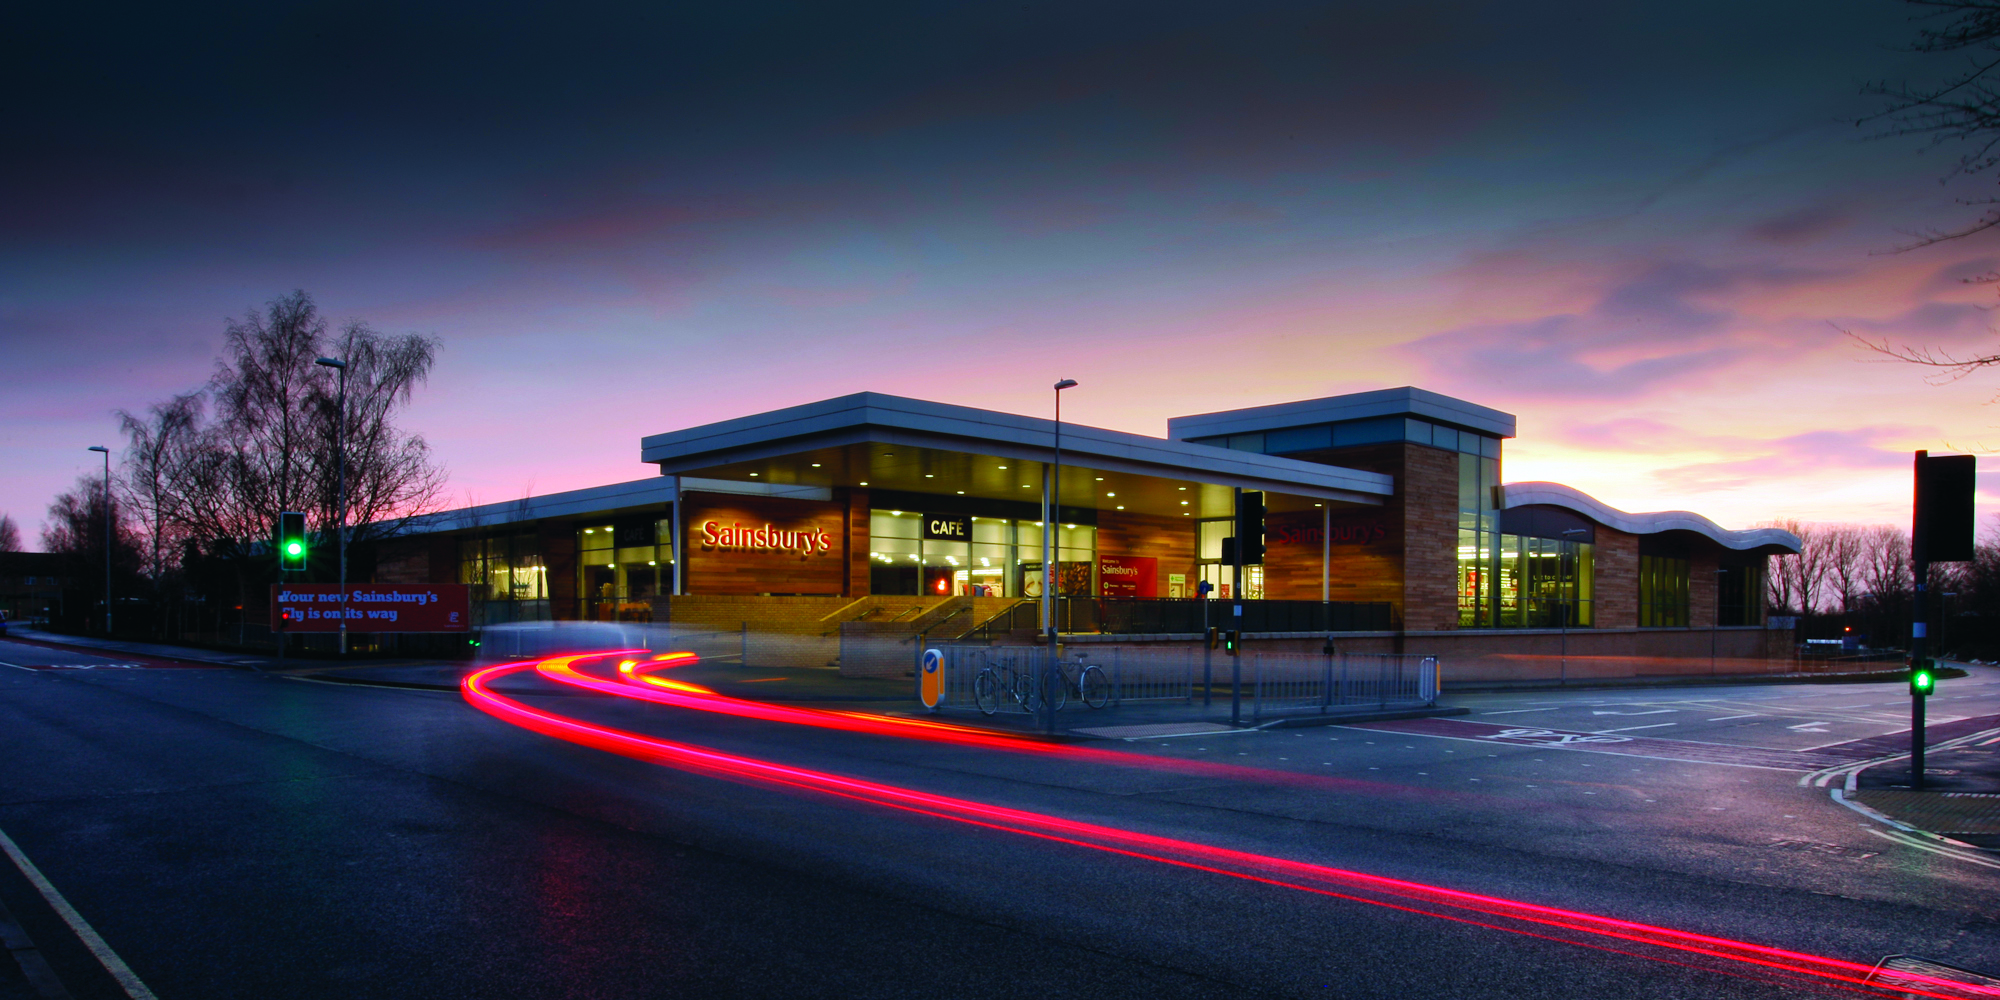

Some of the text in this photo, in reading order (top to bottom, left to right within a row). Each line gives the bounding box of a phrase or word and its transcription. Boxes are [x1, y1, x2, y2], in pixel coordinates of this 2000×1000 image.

[931, 518, 964, 536] CAFÉ
[1279, 521, 1385, 544] Sainsbury's
[702, 520, 831, 556] Sainsbury's
[1102, 564, 1138, 577] Sainsbury's
[282, 590, 438, 605] Your new Sainsbury's
[307, 607, 321, 619] is
[323, 610, 342, 619] on
[345, 607, 363, 619] its
[367, 610, 398, 622] way
